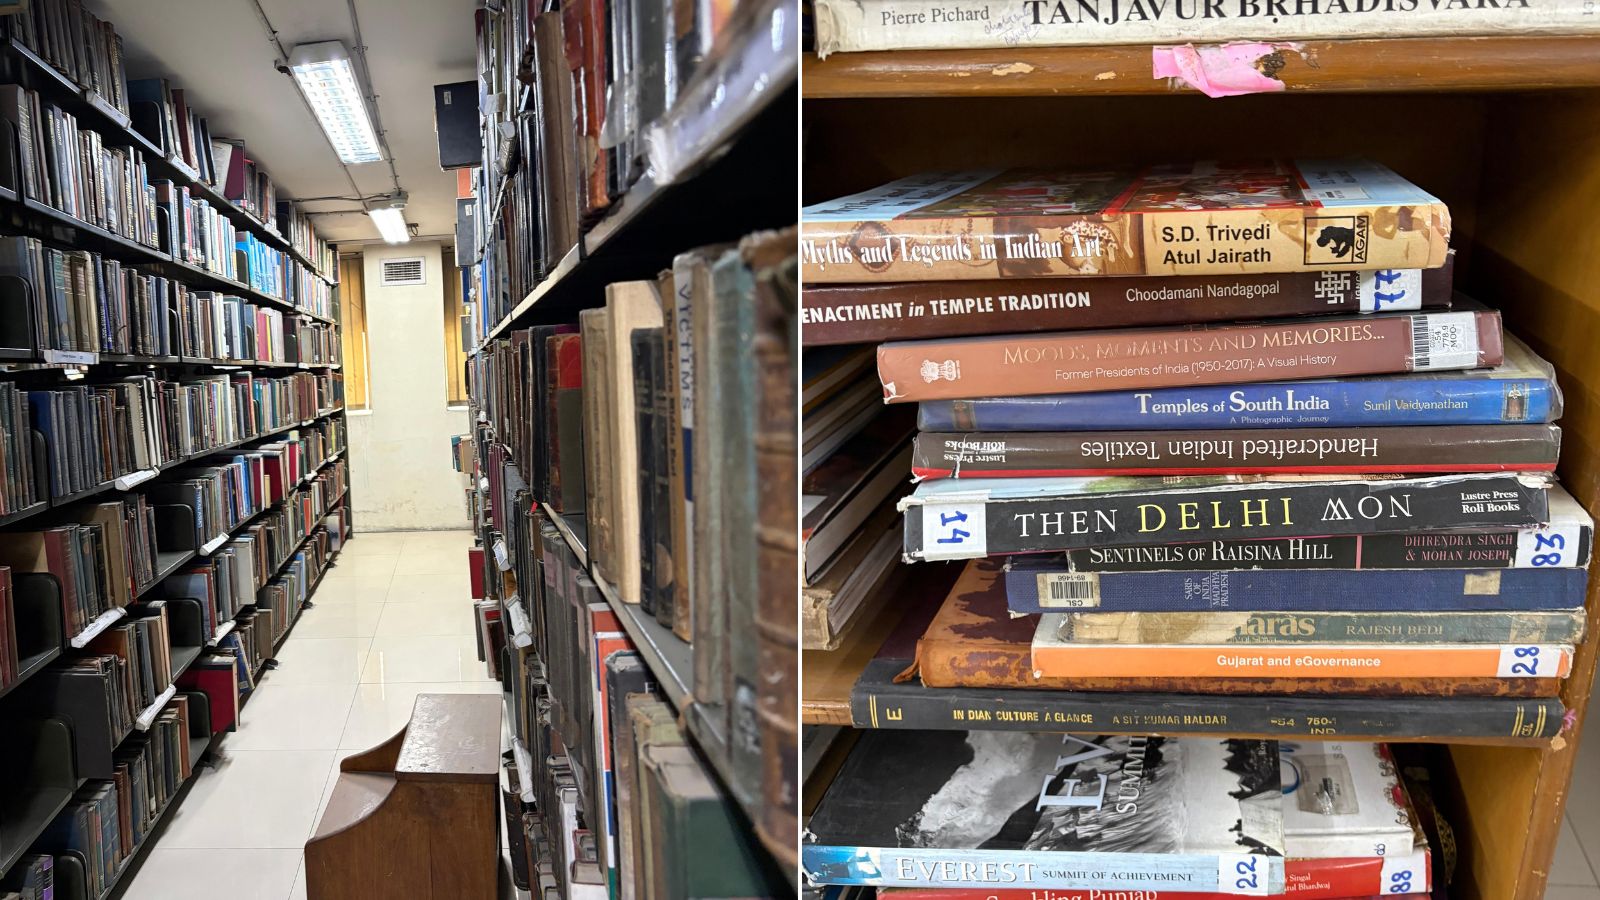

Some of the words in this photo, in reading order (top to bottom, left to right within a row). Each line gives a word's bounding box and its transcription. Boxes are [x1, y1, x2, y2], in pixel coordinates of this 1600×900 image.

[882, 10, 926, 26] Pierre
[931, 5, 990, 24] Pichard
[1024, 0, 1226, 25] TANJAVUR
[1161, 226, 1200, 243] S.D.
[1206, 223, 1271, 242] Trivedi
[1355, 216, 1366, 261] AGAM
[802, 237, 854, 271] Myths
[860, 237, 893, 264] and
[899, 235, 972, 268] Legends
[979, 235, 997, 260] in
[1004, 232, 1063, 260] Indian
[1070, 230, 1103, 258] Art
[1162, 248, 1201, 265] Atul
[1206, 247, 1272, 264] Jairath
[1126, 285, 1203, 302] Choodamani
[1206, 281, 1280, 299] Nandagopal
[908, 301, 925, 317] in
[929, 296, 994, 316] TEMPLE
[998, 291, 1091, 312] TRADITION
[1003, 344, 1089, 366] MOODS,
[1096, 336, 1202, 360] MOMENTS
[1208, 332, 1256, 353] AND
[1262, 324, 1385, 348] MEMORIES...
[1055, 367, 1094, 380] Former
[1095, 363, 1150, 379] Presidents
[1152, 362, 1164, 375] of
[1165, 361, 1189, 375] India
[1191, 357, 1256, 376] (1950-2017):
[1257, 358, 1266, 369] A
[1266, 355, 1298, 368] Visual
[1300, 353, 1337, 368] History
[1134, 393, 1209, 416] Temples
[1212, 399, 1225, 413] of
[1229, 391, 1283, 413] South
[1285, 390, 1330, 411] India
[1363, 399, 1391, 411] Sunil
[1394, 398, 1469, 412] Vaidyanathan
[1229, 416, 1238, 425] A
[1240, 415, 1293, 427] Photographic
[1296, 415, 1330, 426] Journey
[943, 452, 974, 464] Press
[976, 453, 1007, 463] Lustre
[1080, 439, 1161, 460] Textiles
[1167, 439, 1234, 458] Indian
[1242, 437, 1379, 460] Handcrafted
[1460, 491, 1489, 502] Lustre
[1492, 489, 1519, 501] Press
[1461, 502, 1485, 514] Roli
[1487, 500, 1521, 513] Books
[937, 510, 971, 544] 14
[1013, 509, 1118, 537] THEN
[1137, 499, 1294, 533] DELHI
[1405, 534, 1473, 548] DHIRENDRA
[1477, 533, 1513, 546] SINGH
[1531, 533, 1566, 567] 83
[1089, 546, 1184, 565] SENTINELS
[1188, 546, 1207, 561] OF
[1211, 540, 1282, 562] RAISINA
[1287, 538, 1333, 560] HILL
[1405, 550, 1416, 561] &
[1420, 549, 1464, 561] MOHAN
[1468, 548, 1510, 561] JOSEPH
[1184, 577, 1193, 600] SARIS
[1193, 582, 1201, 595] OF
[1201, 576, 1210, 600] INDIA
[1212, 571, 1221, 606] MADHYA
[1066, 599, 1083, 607] CSL
[1345, 625, 1403, 637] RAJESH
[1407, 624, 1444, 636] BEDI
[1216, 655, 1264, 668] Gujarat
[1267, 655, 1292, 667] and
[1294, 656, 1382, 667] eGovernance
[1511, 646, 1540, 676] 28
[995, 710, 1040, 722] CULTURE
[1054, 712, 1094, 724] GLANCE
[1144, 715, 1181, 725] KUMAR
[1183, 715, 1228, 725] HALDAR
[1115, 734, 1149, 814] SUMMIT
[895, 855, 1038, 884] EVEREST
[1042, 869, 1089, 880] SUMMIT
[1091, 870, 1108, 880] OF
[1110, 871, 1194, 883] ACHIEVEMENT
[1235, 855, 1259, 890] 22
[1289, 872, 1312, 884] Singal
[1390, 870, 1413, 893] 88
